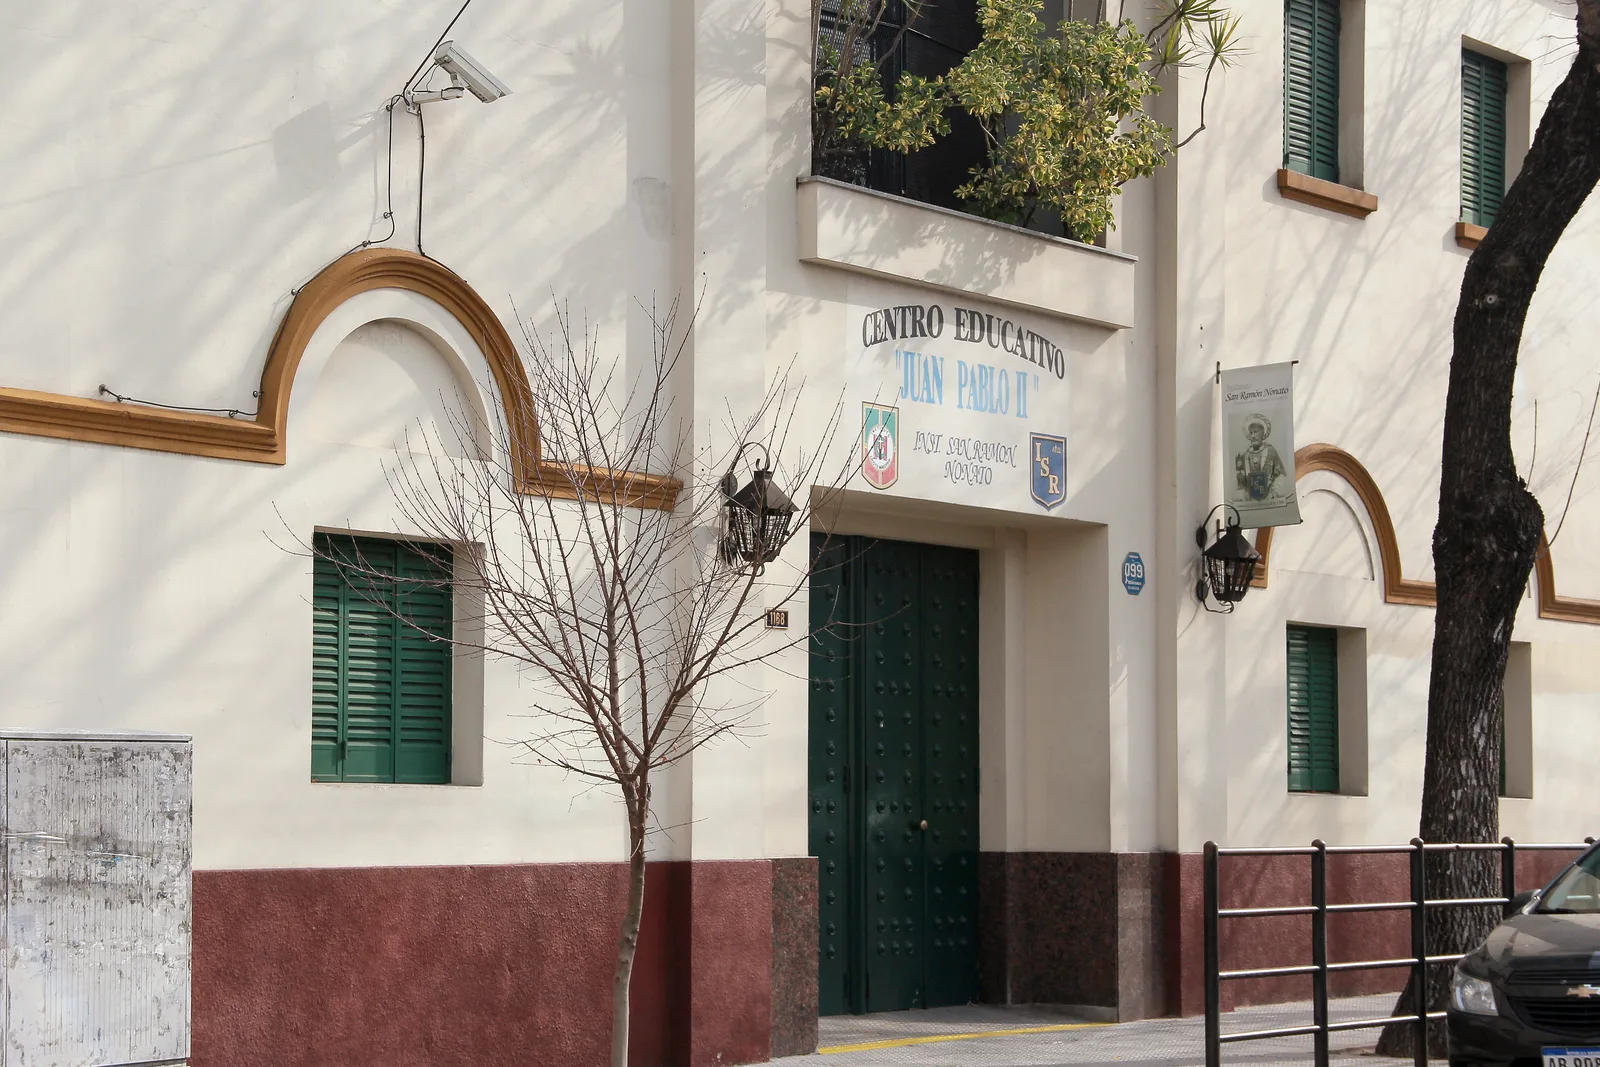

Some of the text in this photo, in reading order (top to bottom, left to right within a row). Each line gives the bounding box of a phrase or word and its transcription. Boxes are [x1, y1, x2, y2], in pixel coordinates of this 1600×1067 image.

[862, 304, 1065, 380] CENTRO EDUCATIVO
[957, 360, 1010, 415] PABLO
[1225, 392, 1238, 402] San
[1262, 387, 1289, 398] Nonato
[946, 437, 971, 461] SAN
[972, 440, 1018, 468] RAMON
[944, 460, 992, 486] NONATO
